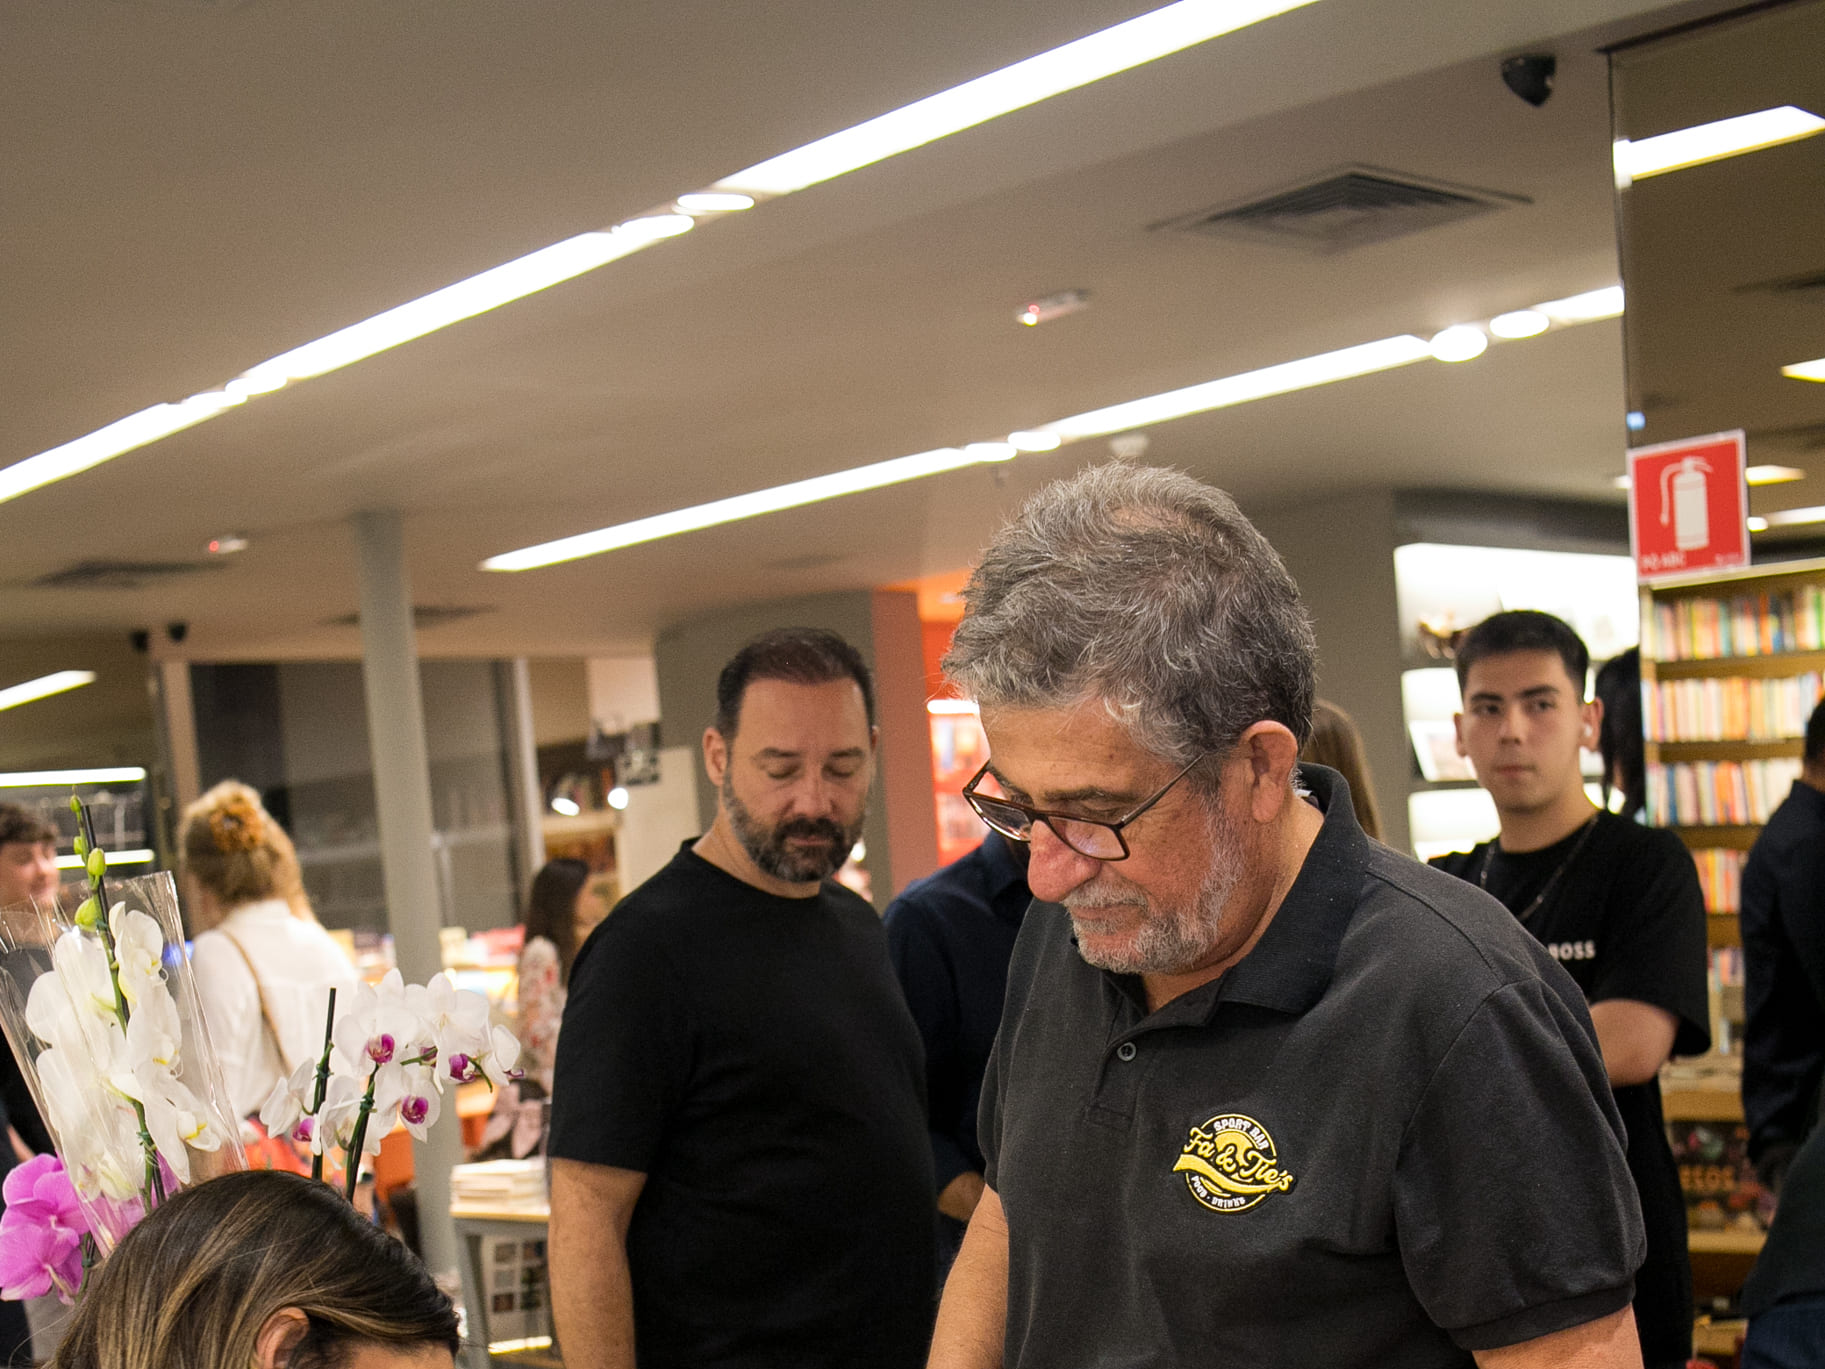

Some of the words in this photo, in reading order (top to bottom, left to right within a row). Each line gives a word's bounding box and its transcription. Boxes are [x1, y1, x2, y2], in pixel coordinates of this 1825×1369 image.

[1213, 1118, 1252, 1132] SPORT
[1249, 1128, 1269, 1150] BAR
[1191, 1175, 1208, 1199] FOOD
[1211, 1197, 1246, 1208] DRINKS
